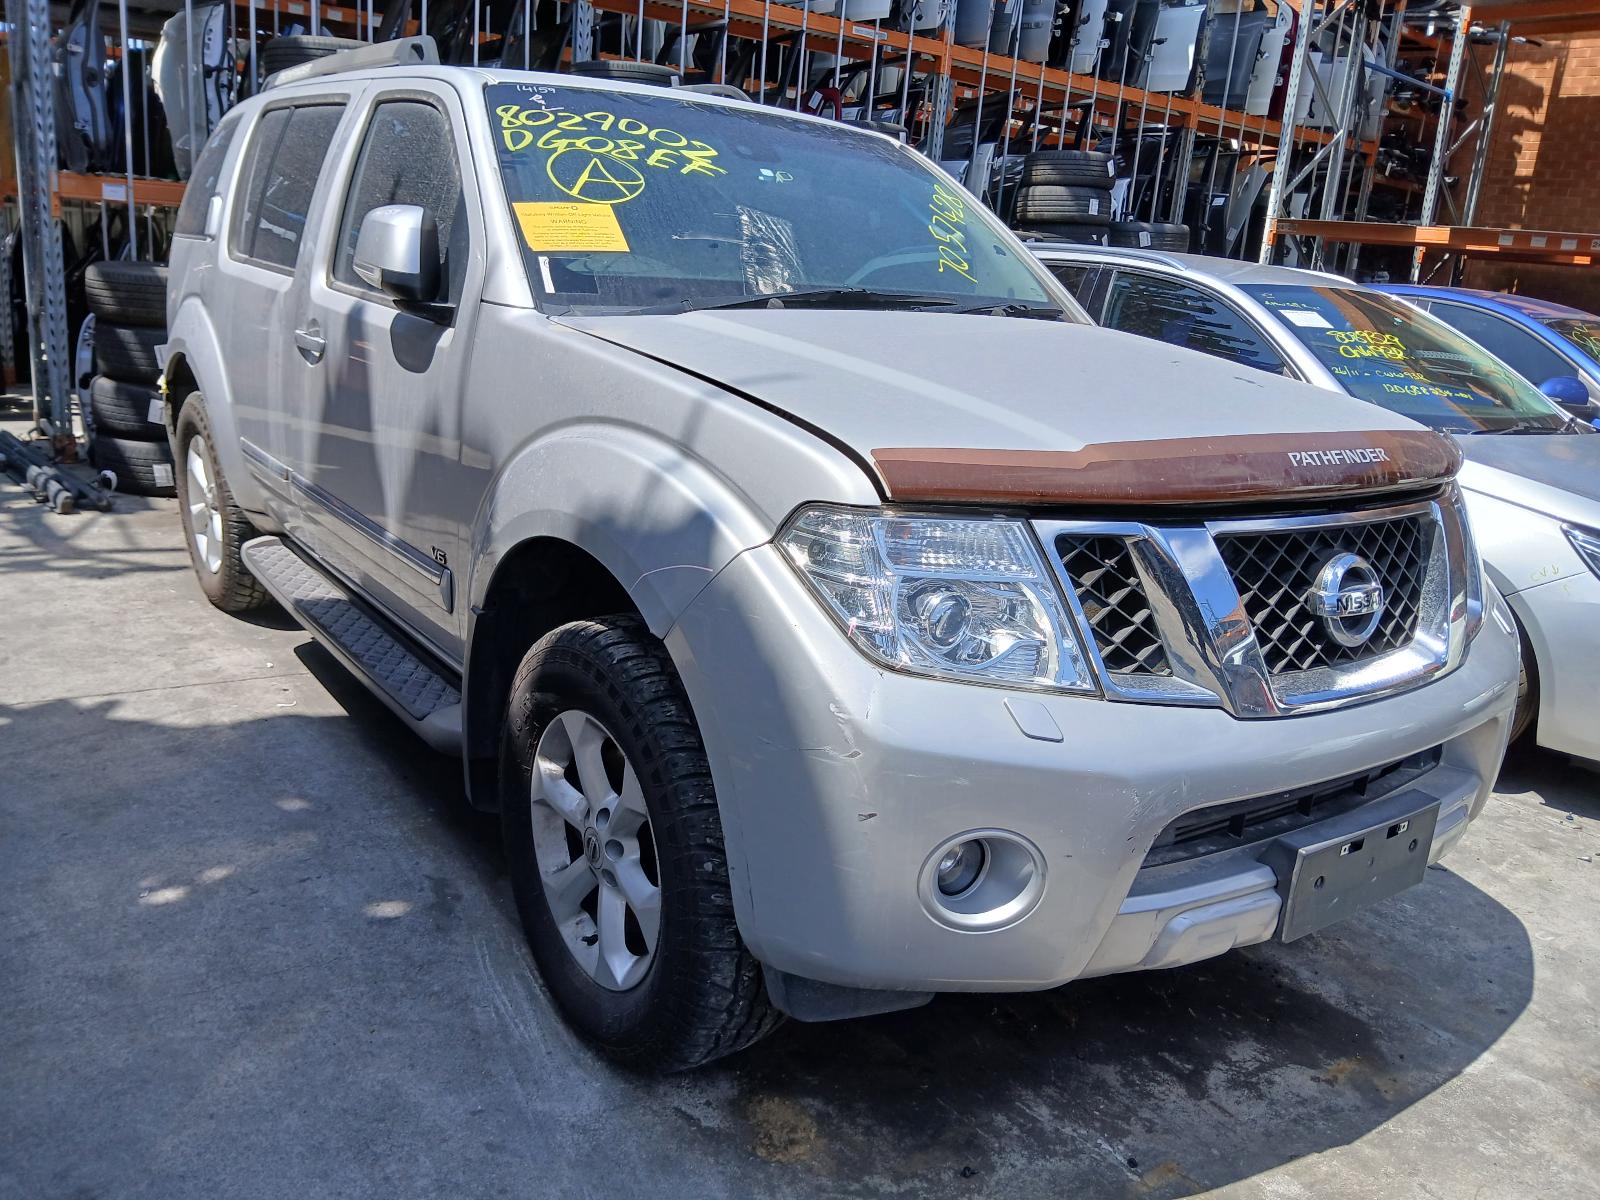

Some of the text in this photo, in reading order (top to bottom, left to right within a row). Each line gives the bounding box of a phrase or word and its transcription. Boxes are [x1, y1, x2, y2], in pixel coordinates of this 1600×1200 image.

[517, 84, 556, 94] 14159
[496, 104, 719, 157] 8029002
[1287, 448, 1390, 467] PATHFINDER
[431, 545, 447, 565] V6
